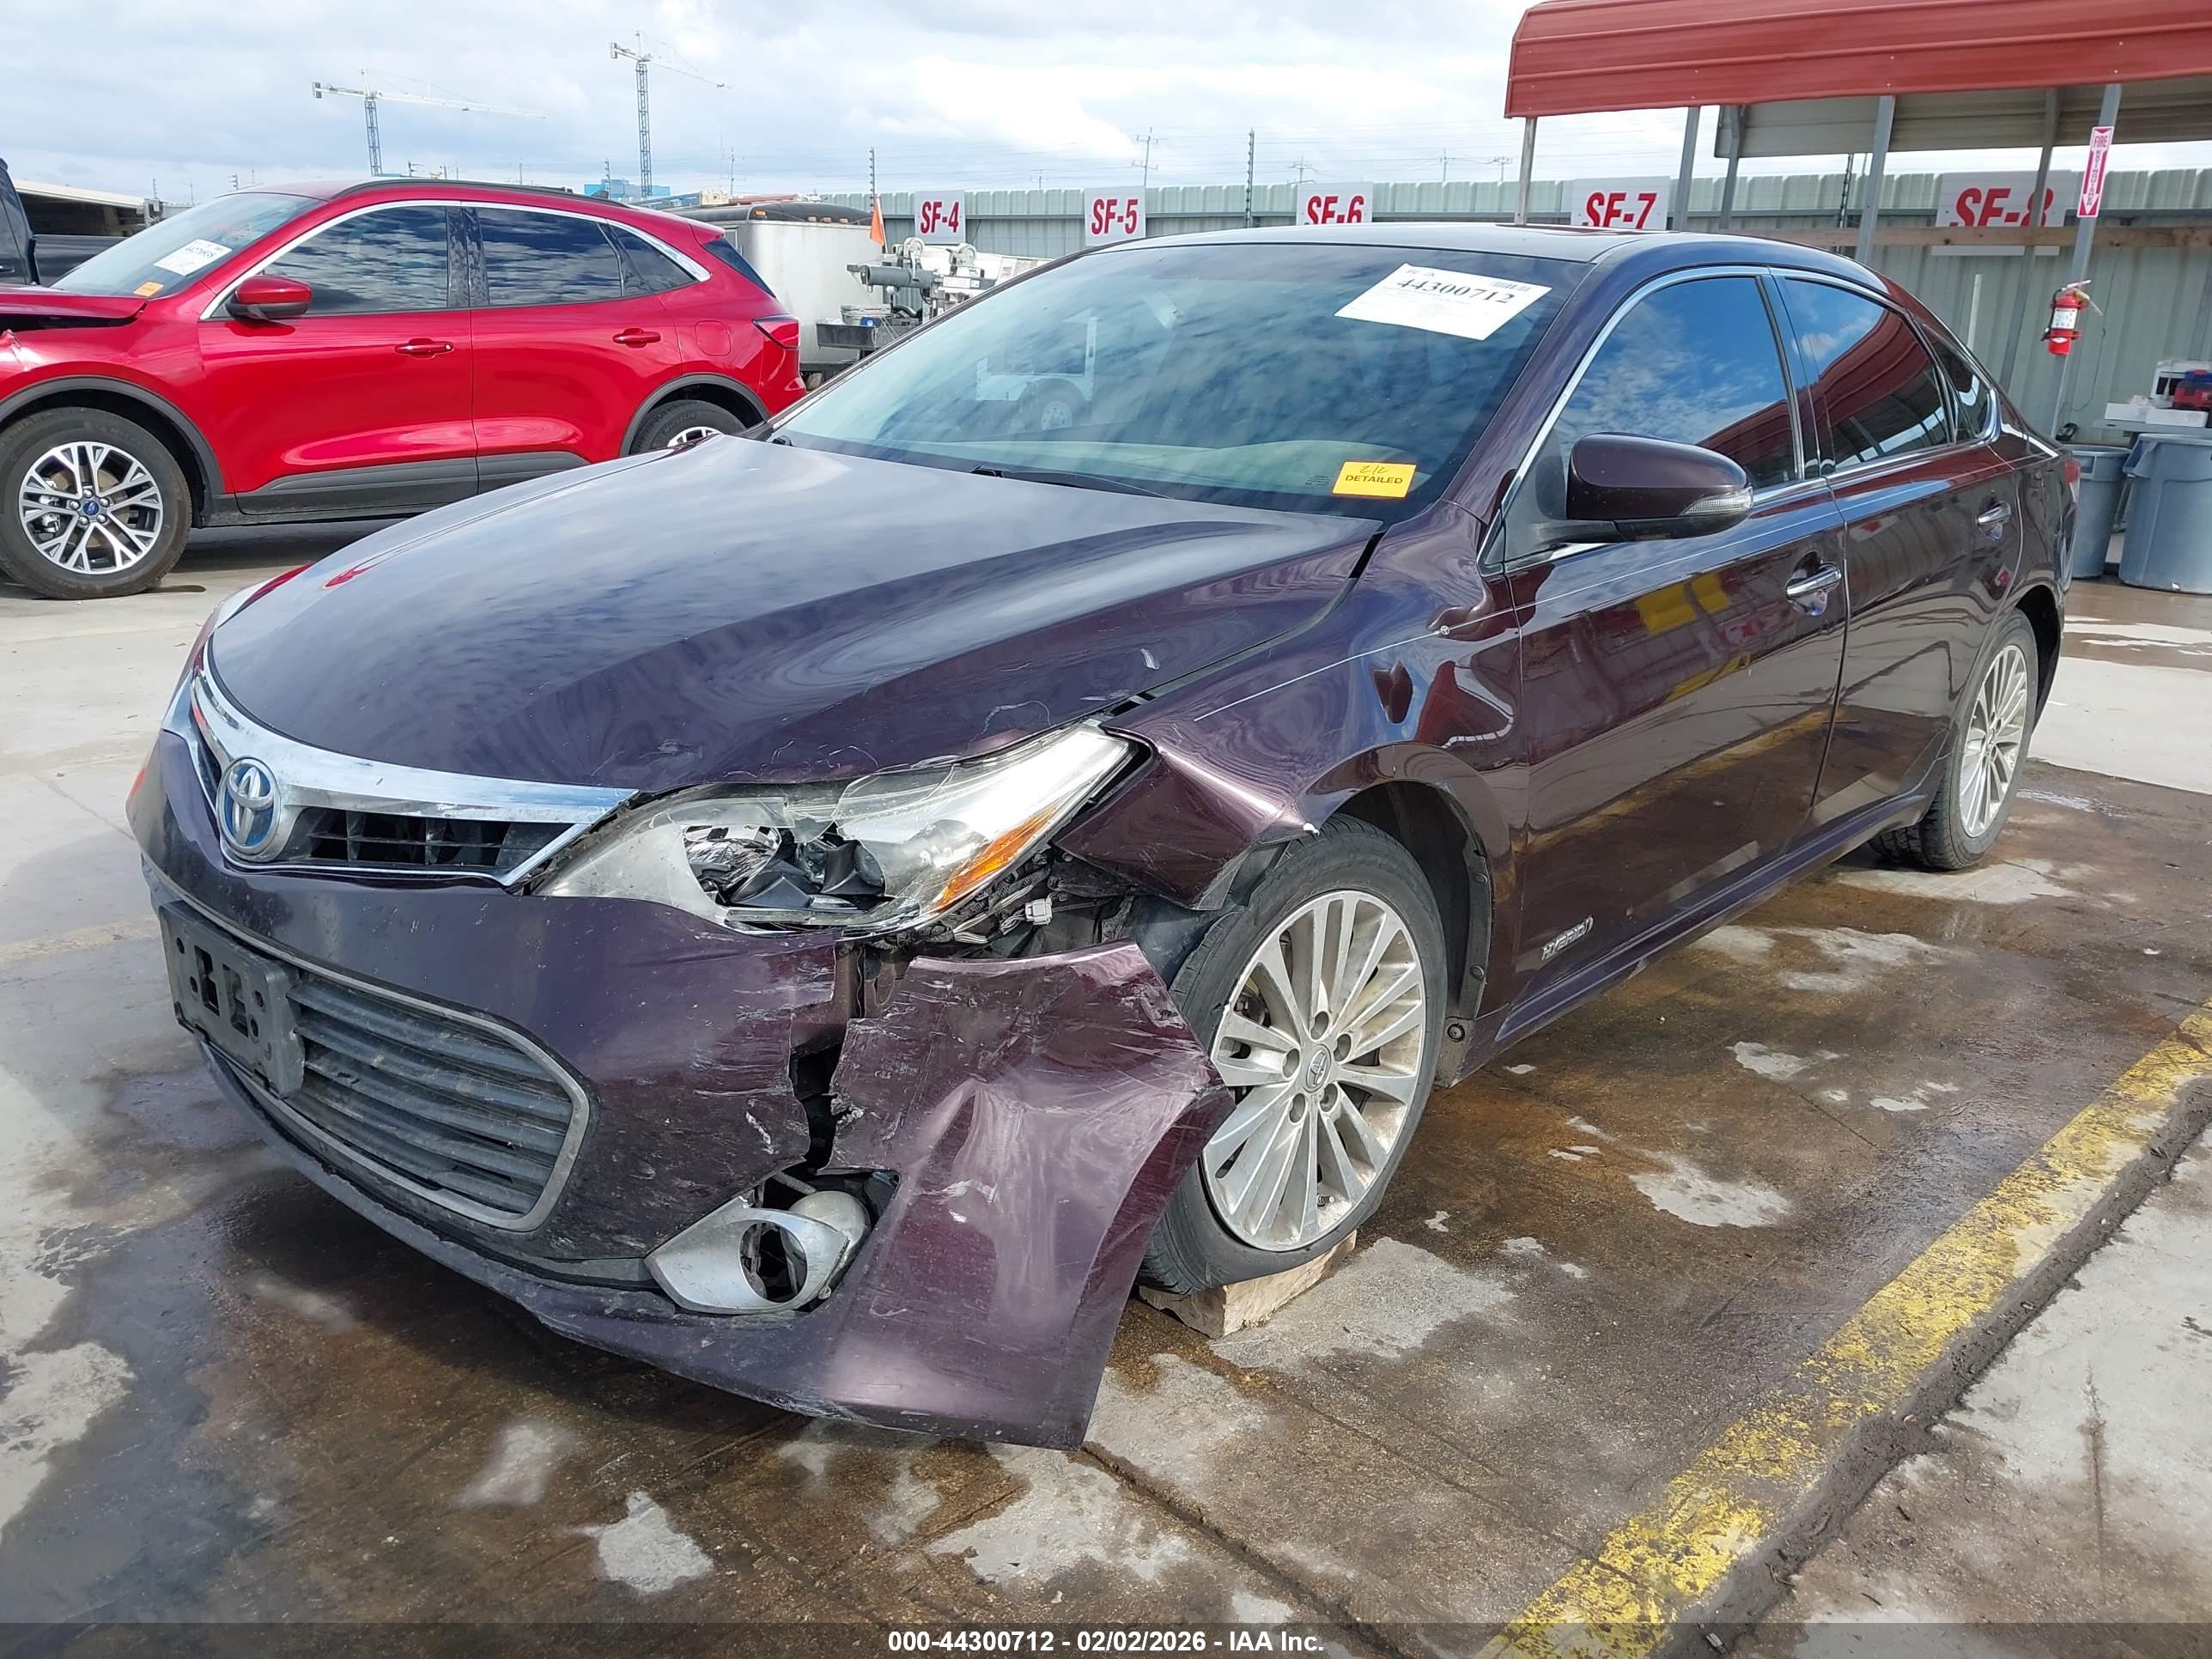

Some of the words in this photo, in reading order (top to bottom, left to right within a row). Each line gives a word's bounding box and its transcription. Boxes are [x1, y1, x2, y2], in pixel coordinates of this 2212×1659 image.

[2094, 135, 2109, 149] FIRE
[920, 200, 959, 234] SF-4
[1091, 198, 1139, 235] SF-5
[1305, 194, 1365, 223] SF-6
[1583, 191, 1658, 228] SF-7
[1396, 276, 1516, 304] 44300712
[1345, 474, 1403, 484] DETAILED
[1540, 923, 1588, 961] HYBRID
